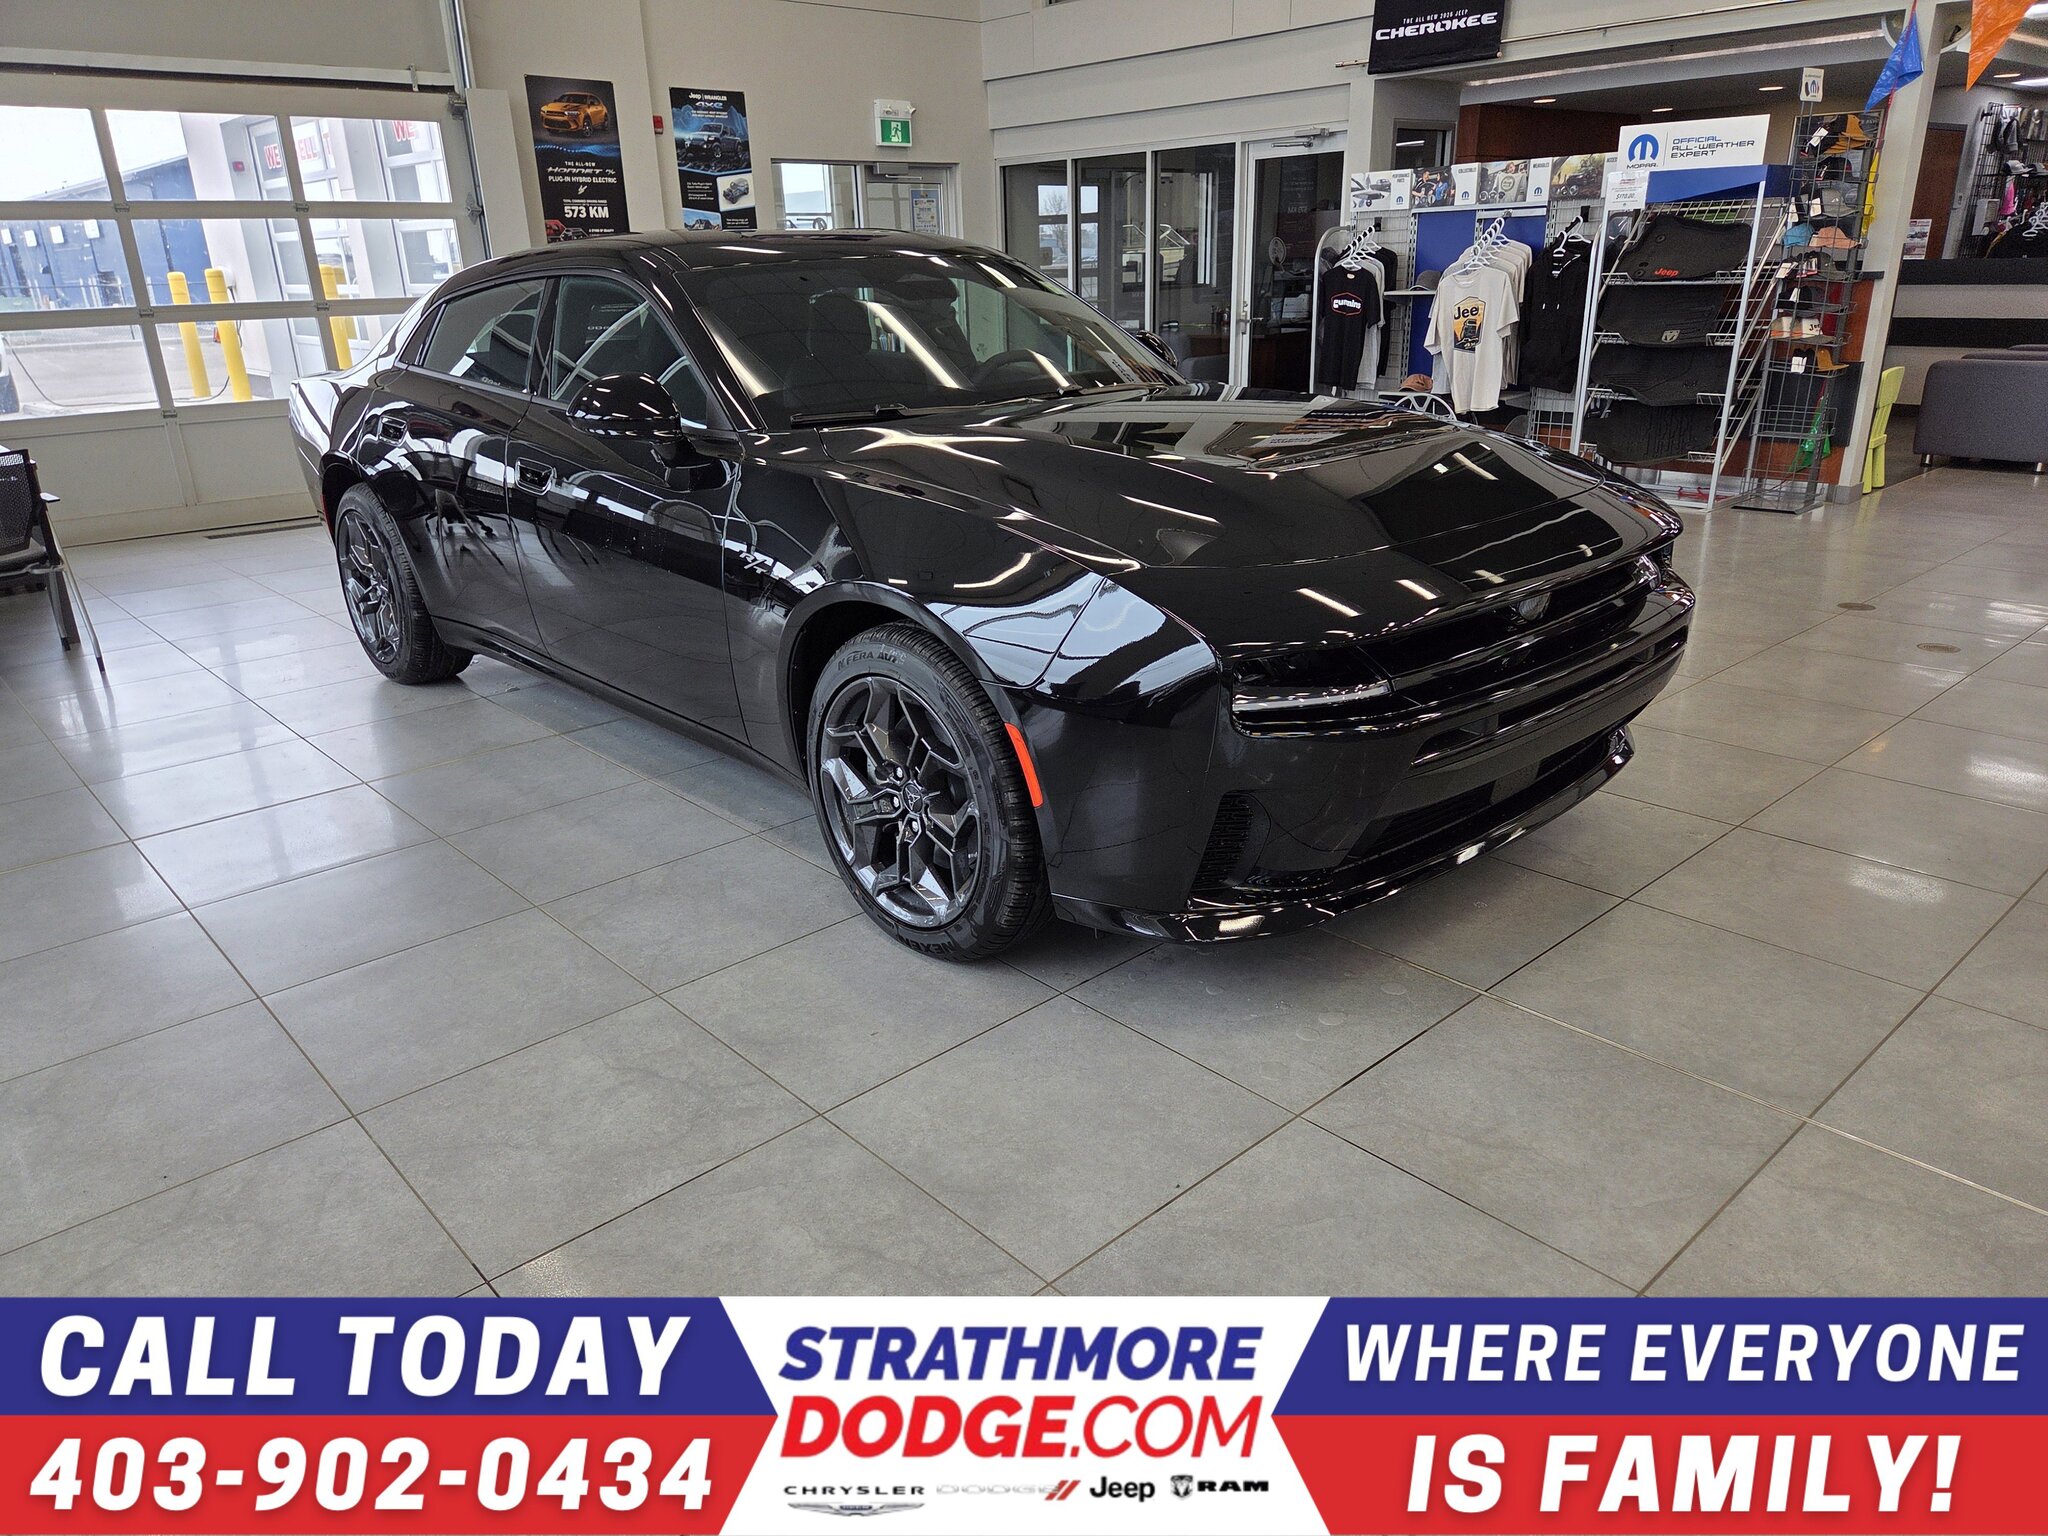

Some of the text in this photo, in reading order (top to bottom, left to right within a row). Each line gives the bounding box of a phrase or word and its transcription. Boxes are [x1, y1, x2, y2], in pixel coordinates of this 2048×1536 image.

[1375, 12, 1498, 41] CHEROKEE
[1672, 135, 1722, 145] OFFICIAL
[1671, 140, 1755, 152] ALL-WEATHER
[1670, 149, 1717, 159] EXPERT
[548, 175, 618, 184] PLUG-IN HYBRID ELECTRIC
[564, 206, 610, 219] 573 KM
[1654, 267, 1679, 278] Jeep
